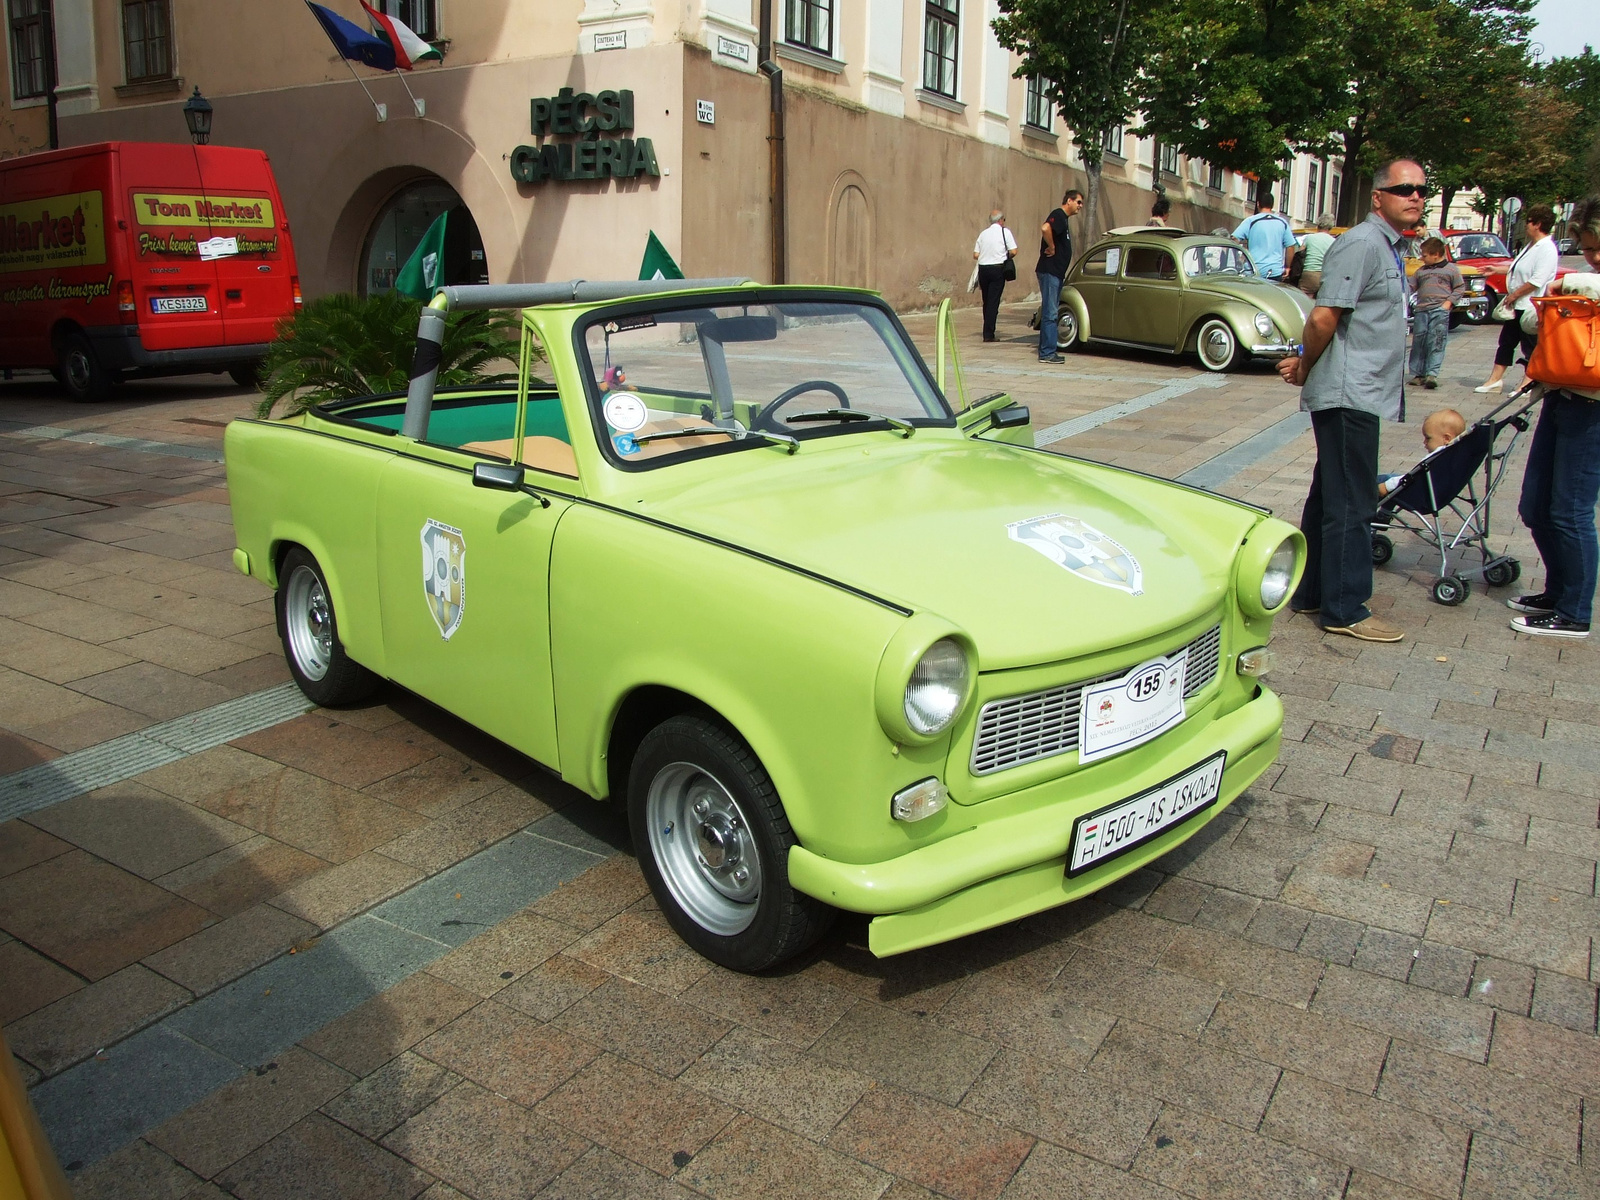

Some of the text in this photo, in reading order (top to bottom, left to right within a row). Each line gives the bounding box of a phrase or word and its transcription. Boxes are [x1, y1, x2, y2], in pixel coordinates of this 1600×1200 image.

[531, 87, 634, 136] PÉCSI
[698, 110, 713, 122] WC
[510, 132, 660, 182] GALÉRIA
[144, 198, 263, 220] Tom Market
[139, 231, 198, 256] Friss kenyér
[26, 252, 44, 264] nagy
[3, 273, 113, 308] naponta háromszor!
[1133, 672, 1161, 698] 155
[1169, 768, 1218, 816] ISKOLA
